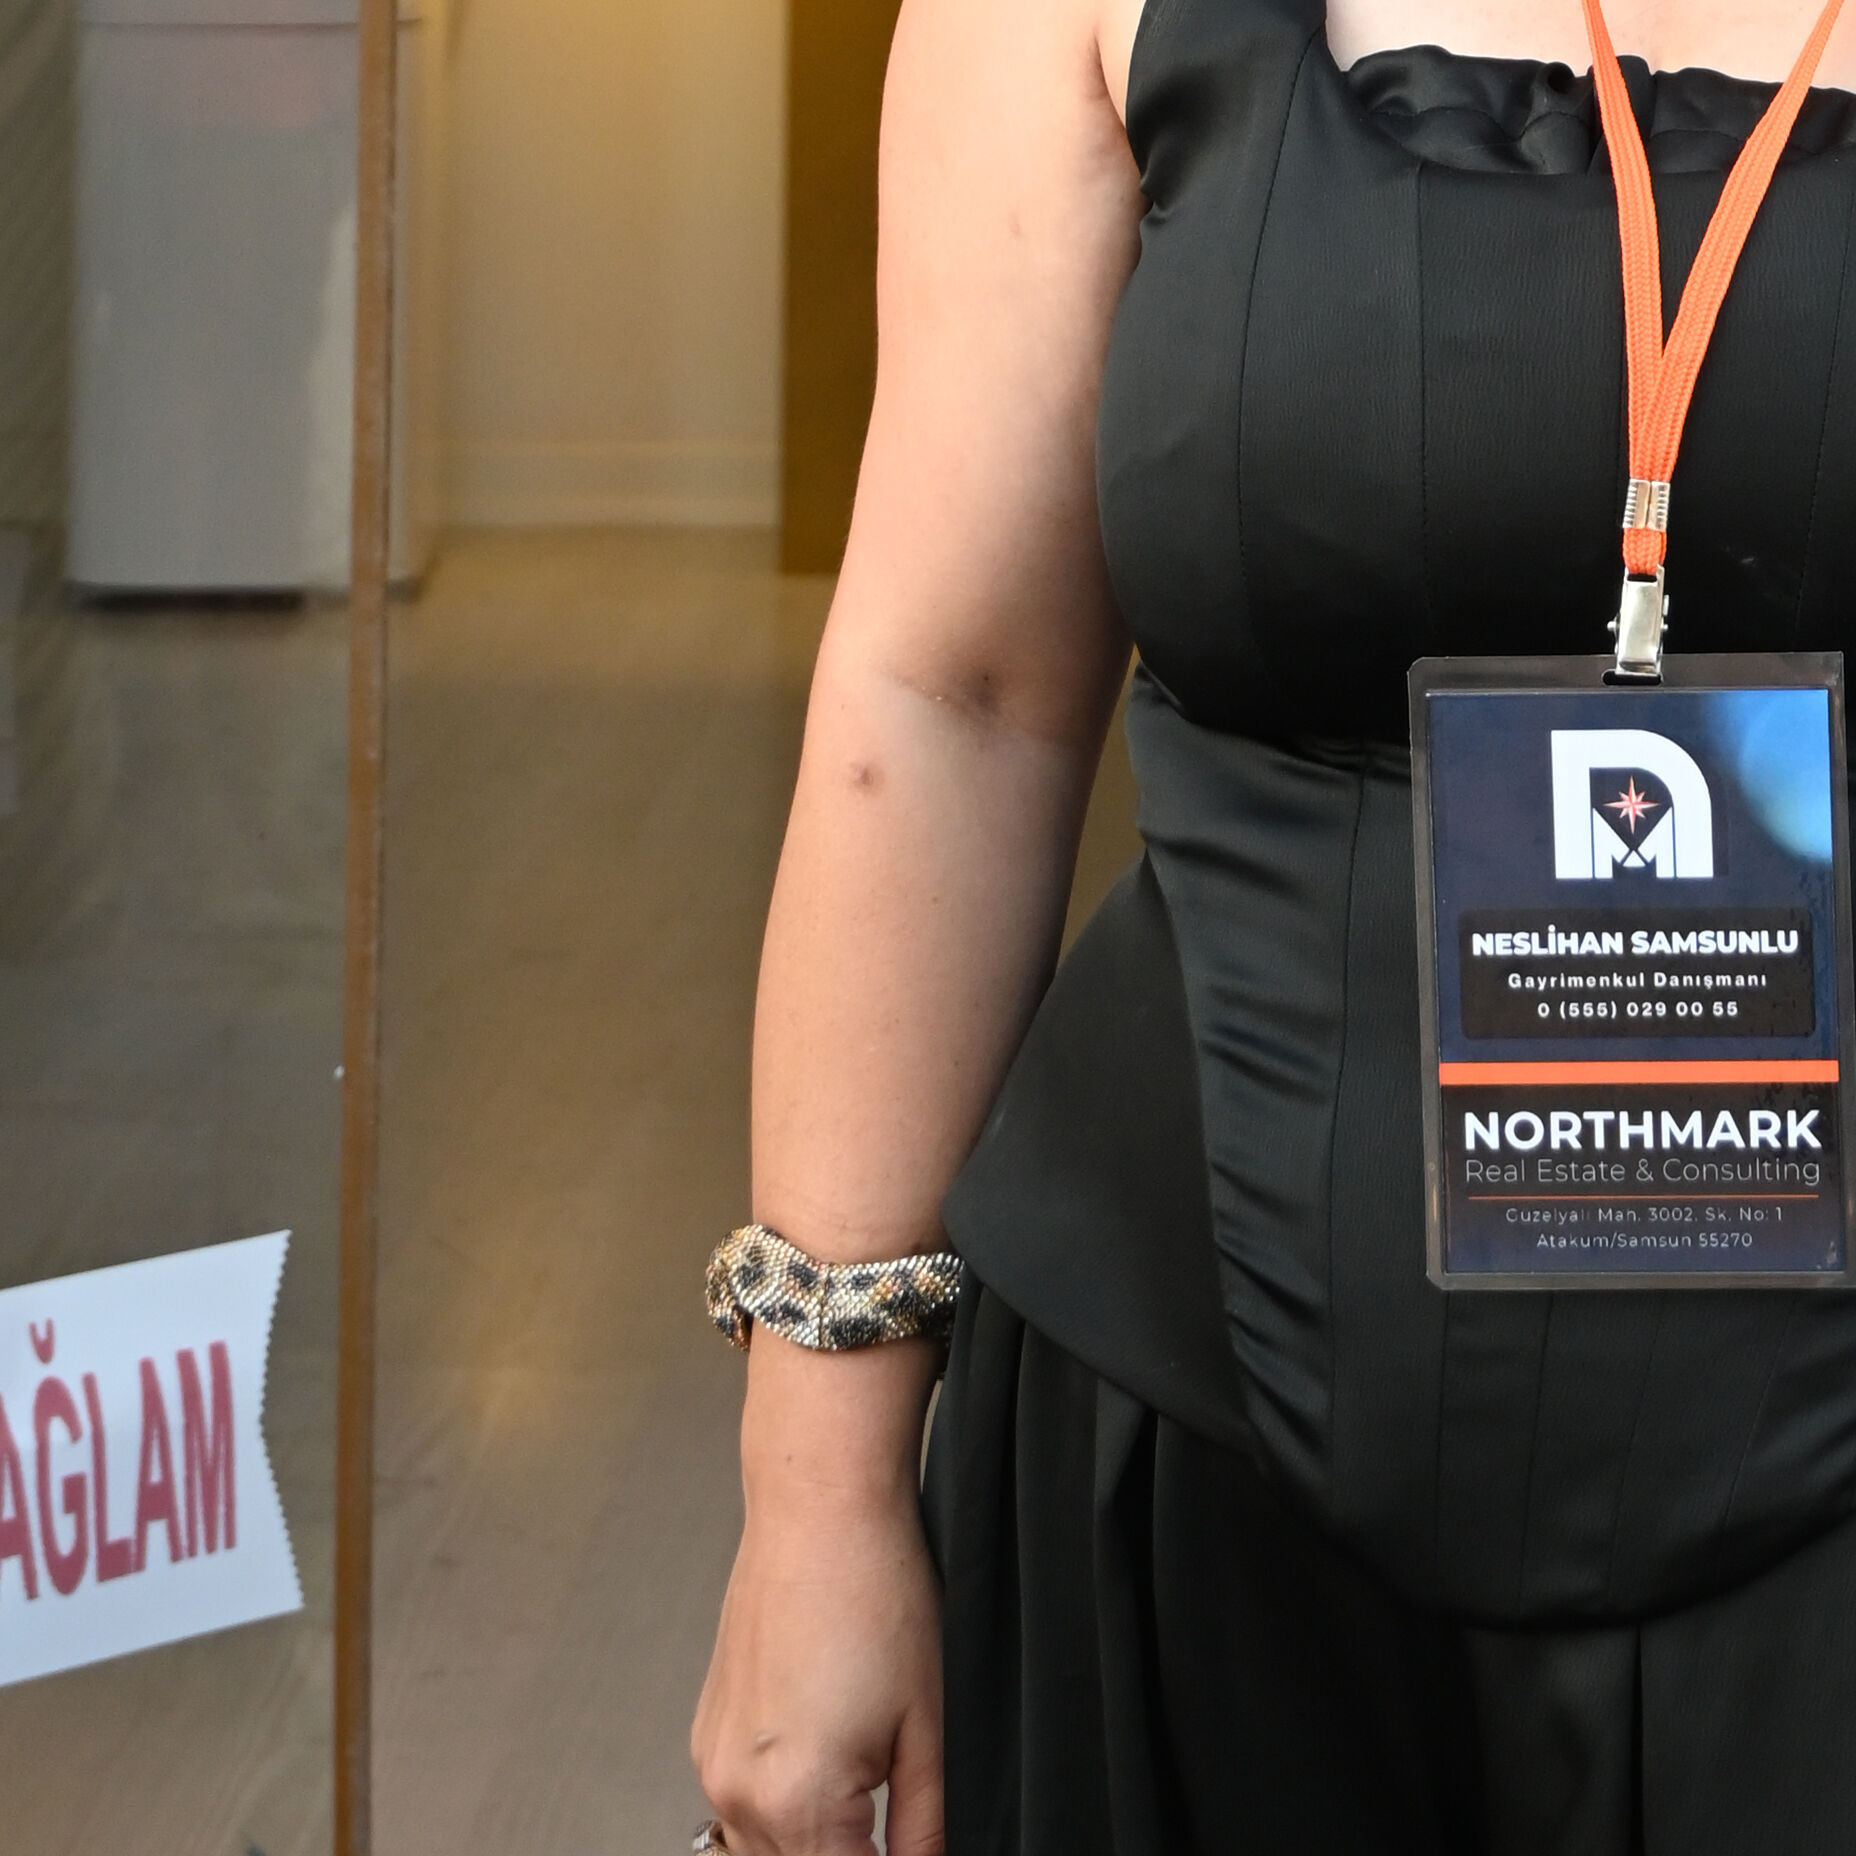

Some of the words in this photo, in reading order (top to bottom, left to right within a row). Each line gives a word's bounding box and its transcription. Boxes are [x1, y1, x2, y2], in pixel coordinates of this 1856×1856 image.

[1472, 924, 1624, 957] NESLİHAN
[1630, 930, 1799, 955] SAMSUNLU
[1507, 971, 1645, 991] Gayrimenkul
[1653, 971, 1767, 990] Danışmanı
[1537, 1002, 1550, 1019] 0
[1559, 1000, 1617, 1020] (555)
[1626, 1001, 1667, 1018] 029
[1675, 1001, 1704, 1017] 00
[1712, 1001, 1738, 1017] 55
[1464, 1109, 1822, 1152] NORTHMARK
[1465, 1158, 1526, 1183] Real
[1537, 1158, 1626, 1183] Estate
[1635, 1158, 1655, 1182] &
[1662, 1156, 1821, 1186] Consulting
[1536, 1231, 1692, 1249] Atakum/Samsun
[1698, 1231, 1754, 1249] 55270
